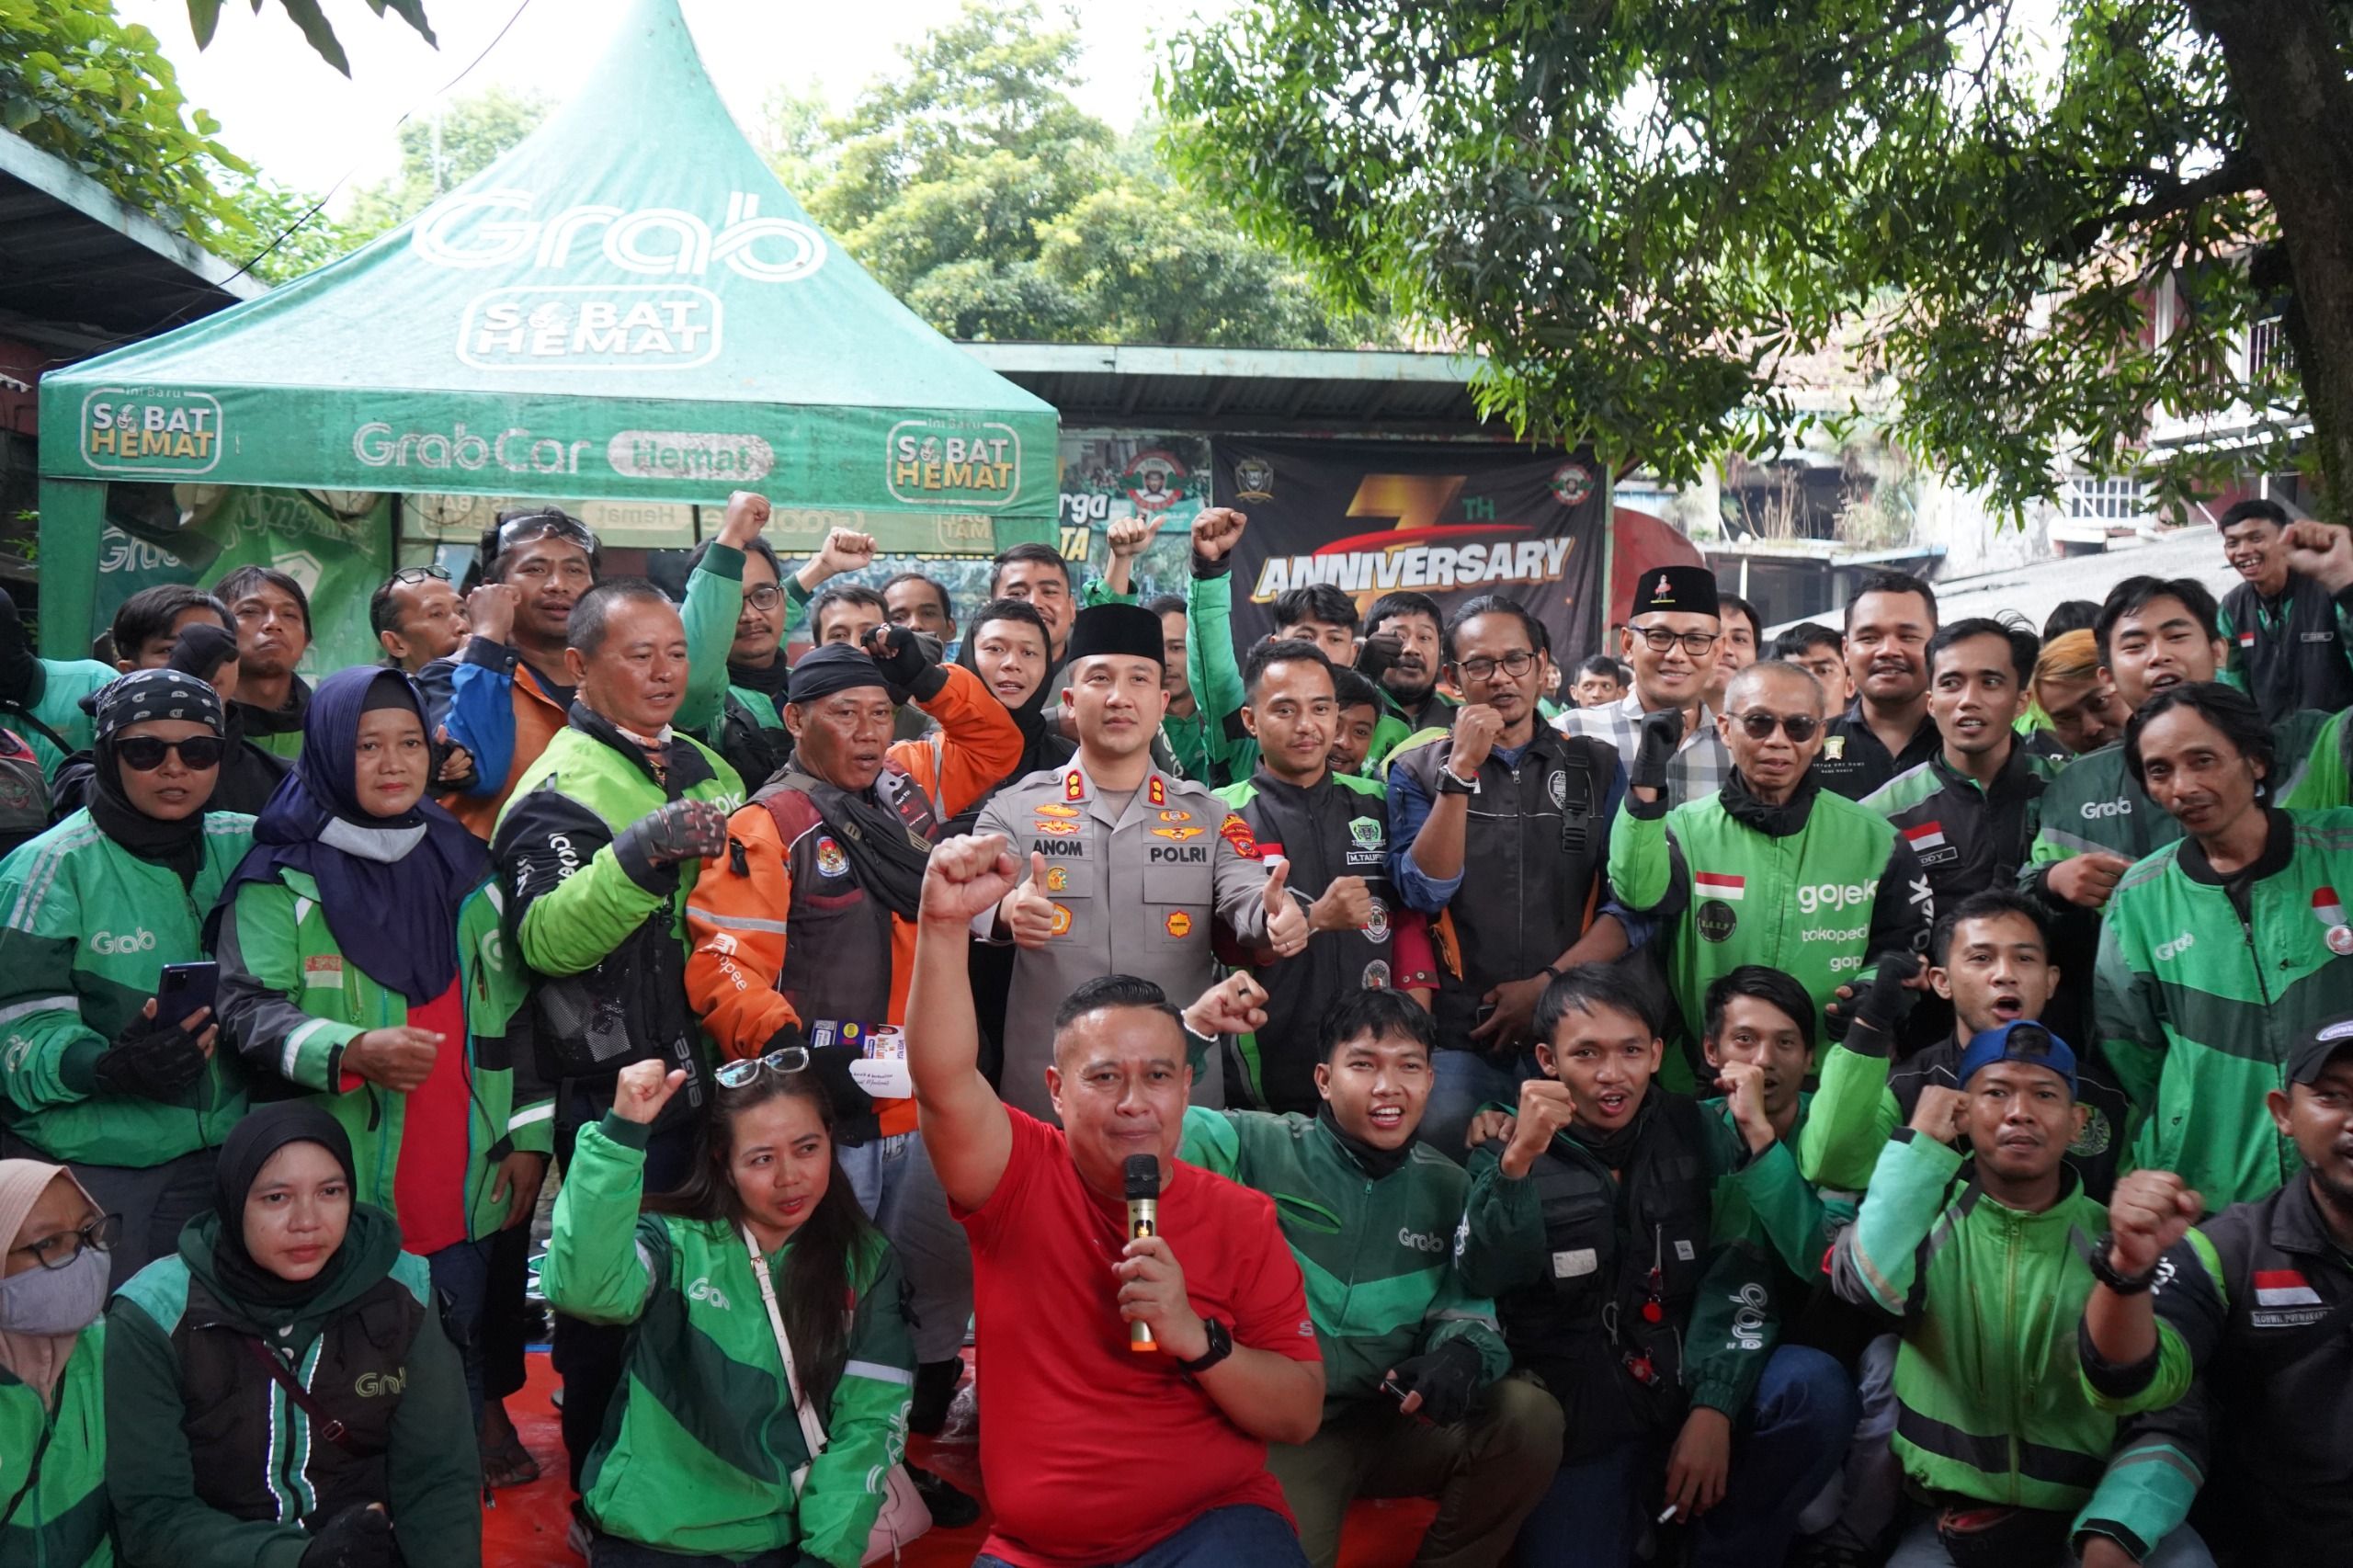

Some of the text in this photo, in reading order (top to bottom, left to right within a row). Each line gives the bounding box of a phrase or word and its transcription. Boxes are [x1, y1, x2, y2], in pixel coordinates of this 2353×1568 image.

[413, 189, 828, 282] Grab
[477, 325, 708, 358] HEMAT
[147, 386, 181, 397] Baru
[91, 428, 214, 458] HEMAT
[631, 437, 753, 473] Hemat
[895, 460, 1014, 491] HEMAT
[1059, 493, 1108, 525] rga
[1462, 496, 1496, 522] TH
[1254, 536, 1574, 600] ANNIVERSARY
[2080, 795, 2132, 820] Grab
[1033, 839, 1083, 857] ANOM
[1150, 846, 1207, 863] POLRI
[1798, 878, 1879, 915] gojek
[91, 926, 156, 955] Grab
[1802, 925, 1869, 944] tokoped
[1398, 1227, 1445, 1253] Grab
